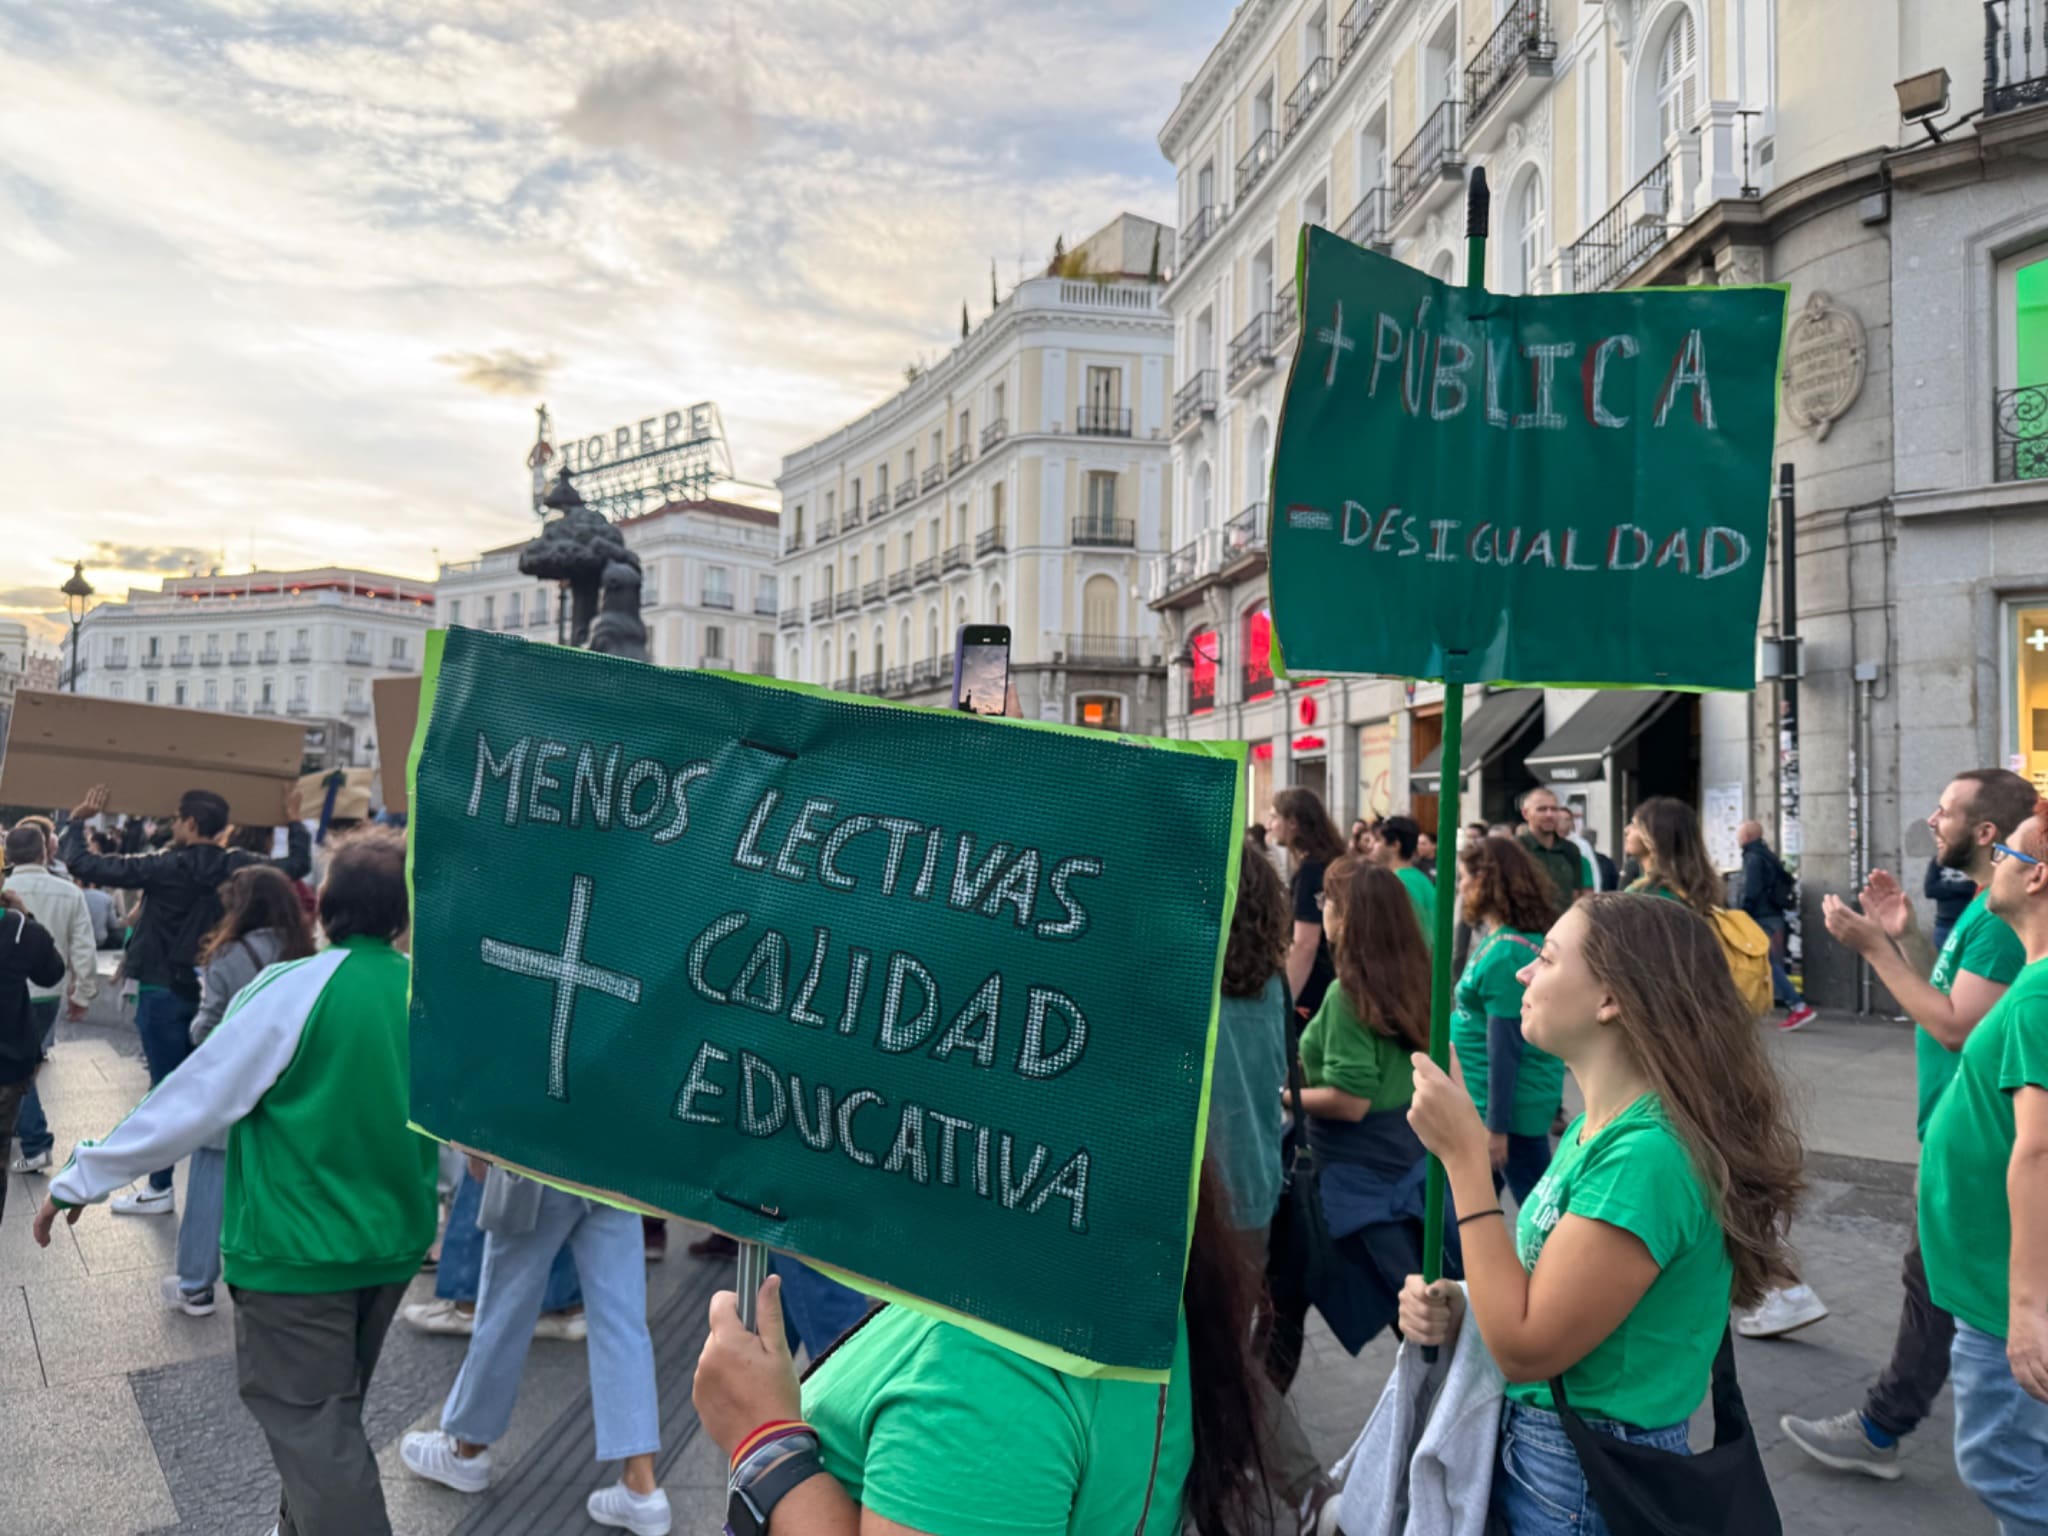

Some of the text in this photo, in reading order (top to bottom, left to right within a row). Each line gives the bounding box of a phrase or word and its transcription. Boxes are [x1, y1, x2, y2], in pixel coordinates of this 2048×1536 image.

[560, 435, 603, 472] TIO
[615, 401, 712, 459] PEPE
[1368, 295, 1718, 430] PÚBLICA
[1340, 500, 1751, 580] DESIGUALDAD
[467, 731, 1103, 940] MENOS LECTIVAS
[687, 912, 1090, 1080] CALIDAD
[673, 1041, 1092, 1232] EDUCATIVA
